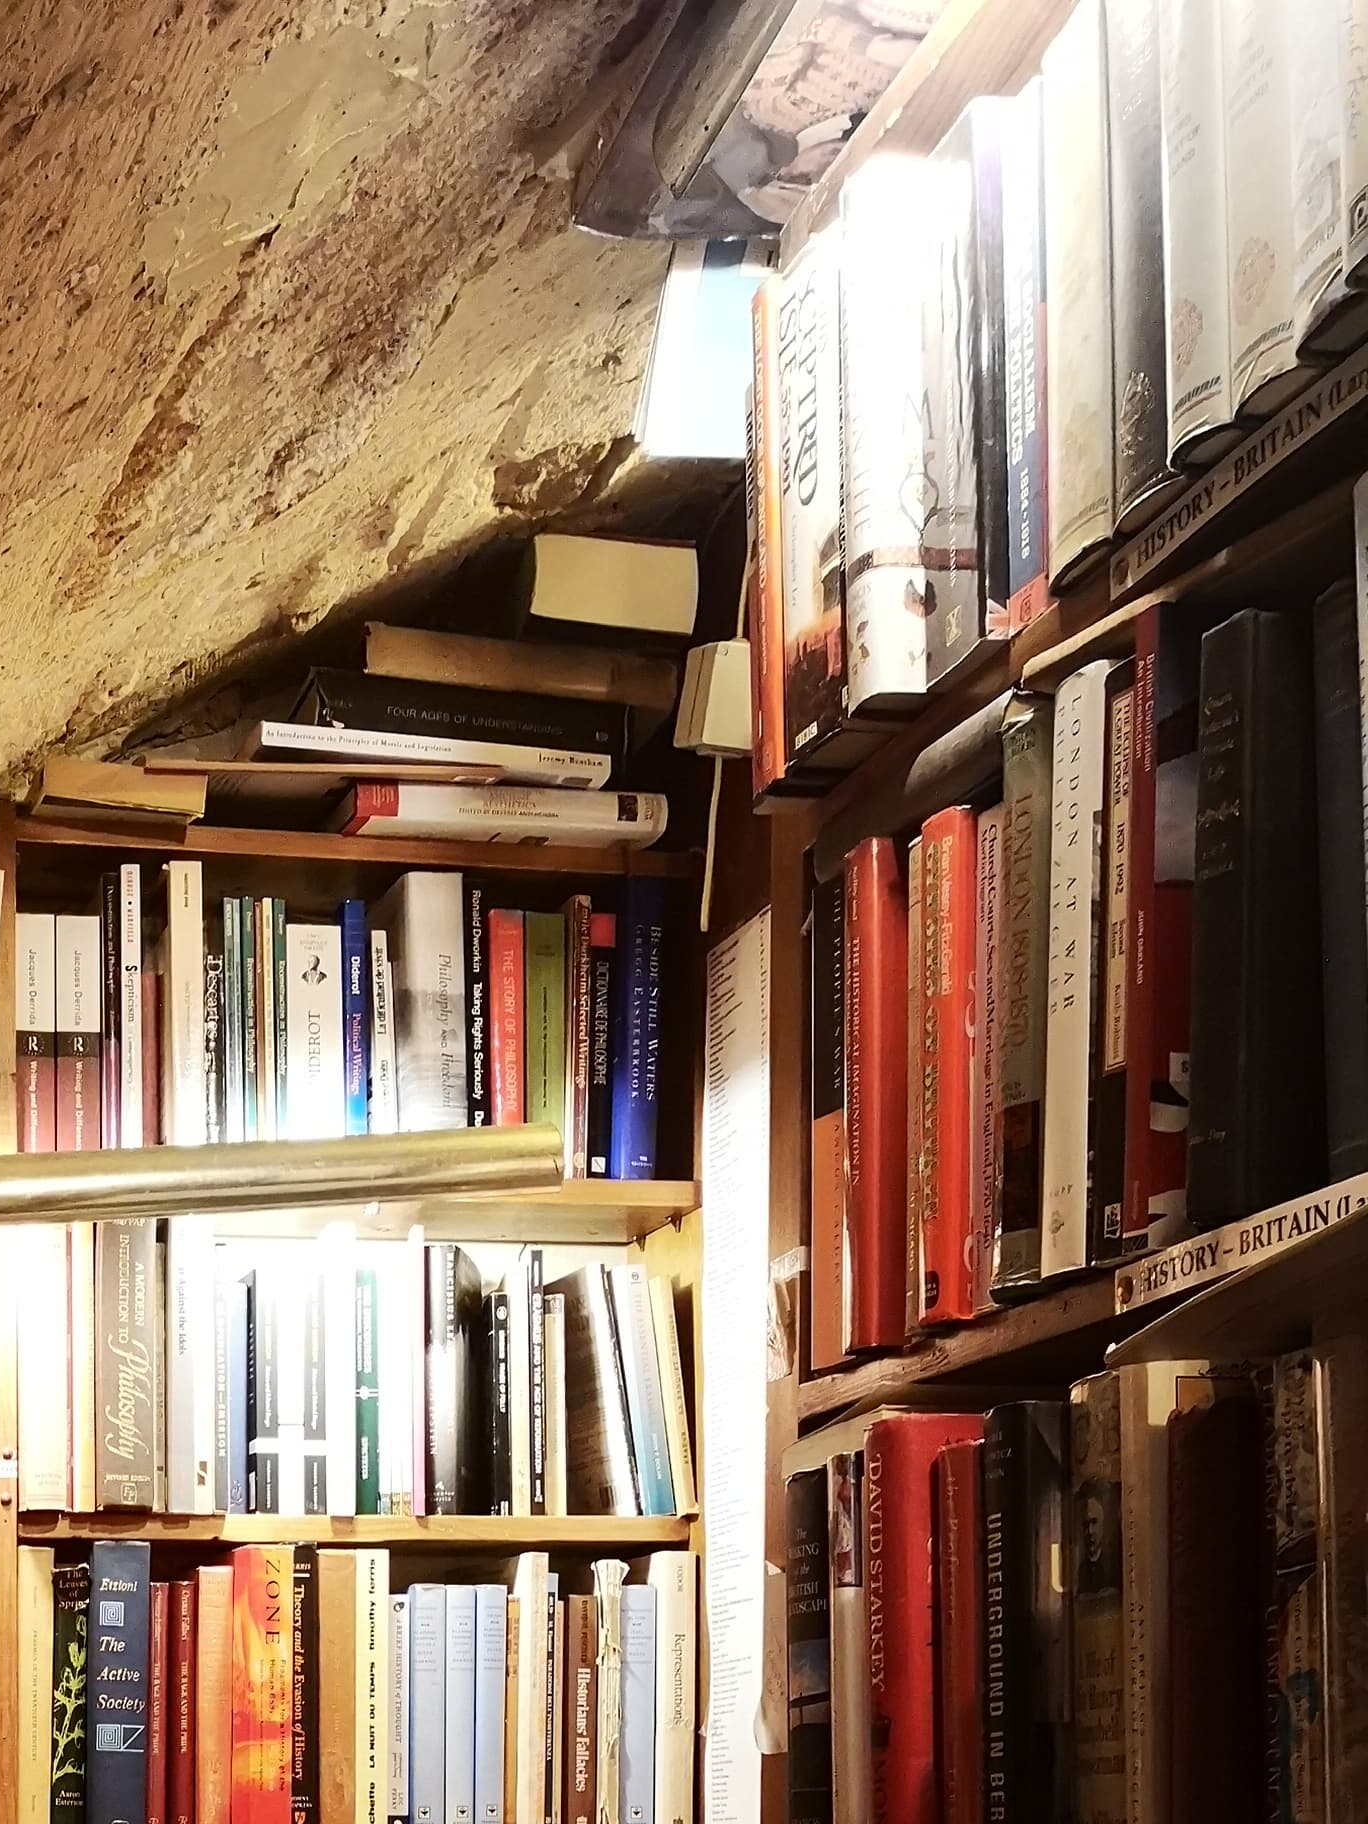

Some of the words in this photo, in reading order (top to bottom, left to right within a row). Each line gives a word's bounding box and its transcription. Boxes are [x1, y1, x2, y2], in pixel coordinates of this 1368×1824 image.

[1064, 691, 1083, 849] LONDON
[472, 890, 482, 927] Ronald
[1063, 877, 1079, 911] AT
[73, 950, 83, 988] Jacques
[472, 928, 483, 973] Dworkin
[503, 949, 514, 972] THE
[503, 977, 516, 1014] STORY
[1062, 936, 1078, 1013] WAR
[73, 991, 83, 1026] Derrida
[472, 982, 484, 1015] Taking
[647, 987, 659, 1031] STILL
[472, 1017, 484, 1050] Rights
[504, 1018, 516, 1035] OF
[631, 987, 644, 1099] EASTERBROOK
[472, 1052, 485, 1099] Seriously
[504, 1039, 518, 1113] PHILOSOPHY
[646, 1039, 658, 1100] WATERS
[135, 1262, 145, 1272] A
[1142, 1241, 1219, 1293] HISTORY
[1240, 1201, 1331, 1256] BRITAIN
[118, 1234, 130, 1323] INTRODUCTION
[135, 1274, 145, 1326] MODERN
[119, 1327, 129, 1344] TO
[104, 1334, 152, 1460] Philosophy
[866, 1452, 884, 1552] DAVID
[264, 1560, 281, 1645] ZONE
[292, 1585, 305, 1629] Theory
[868, 1555, 886, 1692] STARKEY
[986, 1511, 1005, 1718] UNDERGROUND
[99, 1636, 126, 1653] The
[294, 1631, 304, 1654] and
[294, 1655, 305, 1673] the
[96, 1665, 141, 1682] Active
[96, 1694, 146, 1714] Society
[294, 1674, 305, 1720] Evasion
[292, 1723, 306, 1736] of
[990, 1731, 1005, 1755] IN
[292, 1736, 305, 1780] History
[575, 1737, 590, 1792] Fallacies
